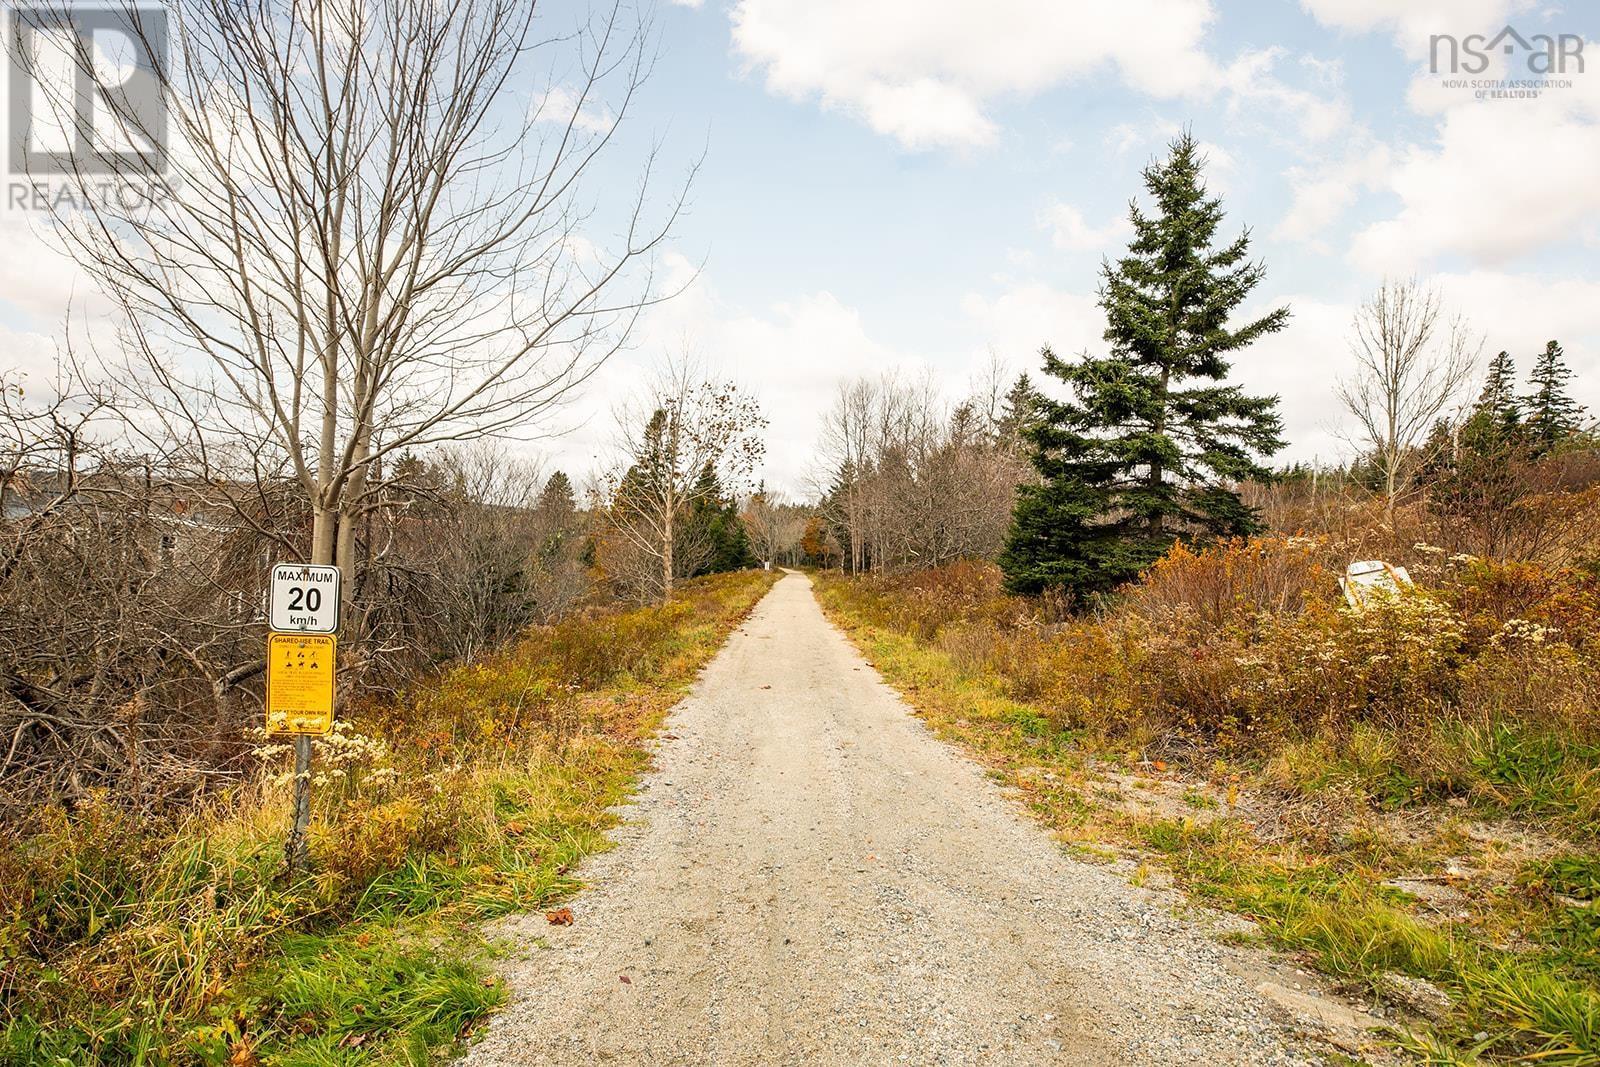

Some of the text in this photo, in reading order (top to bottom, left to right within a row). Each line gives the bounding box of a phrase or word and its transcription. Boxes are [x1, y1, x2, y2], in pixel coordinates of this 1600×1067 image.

[277, 571, 333, 583] MAXIMUM
[287, 587, 322, 612] 20
[289, 615, 318, 626] km/h
